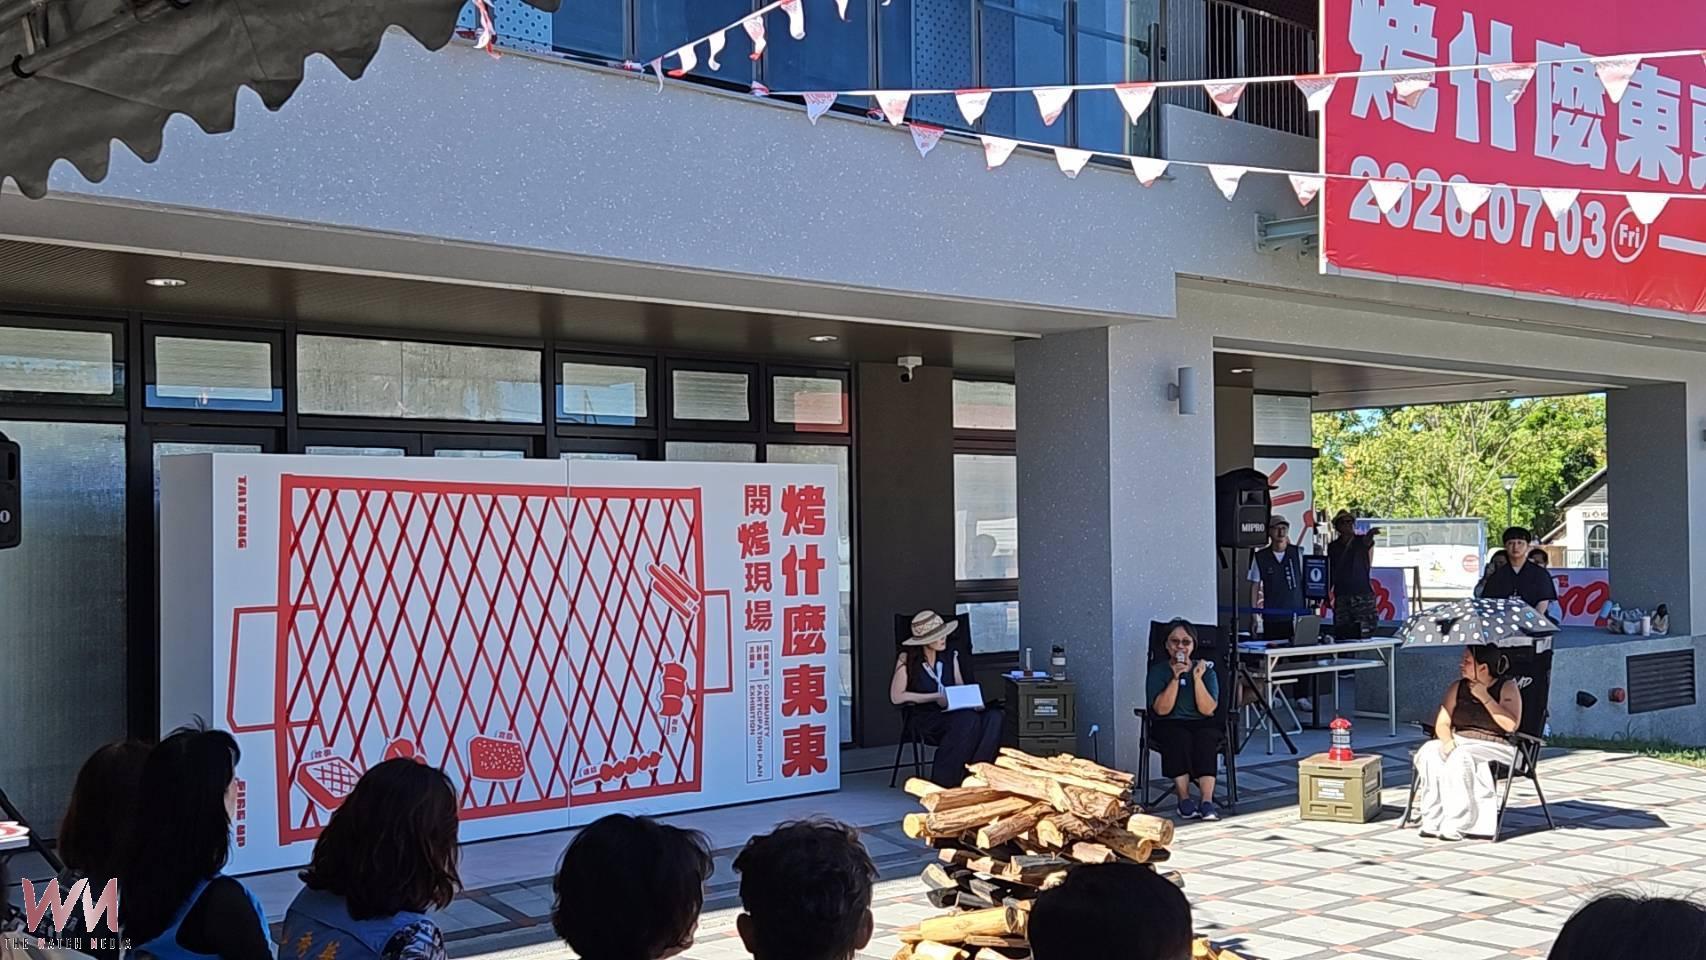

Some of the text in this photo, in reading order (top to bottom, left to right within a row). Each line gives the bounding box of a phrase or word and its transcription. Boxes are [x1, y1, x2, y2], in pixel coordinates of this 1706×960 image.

[1349, 0, 1706, 190] 烤什麼東
[1349, 155, 1641, 259] 2026.07.03 Fri
[236, 474, 247, 549] TAITUNG
[737, 484, 772, 632] 開烤現場
[1241, 523, 1265, 532] MIPRO
[781, 484, 827, 778] 烤什麼東東
[236, 824, 246, 848] UP
